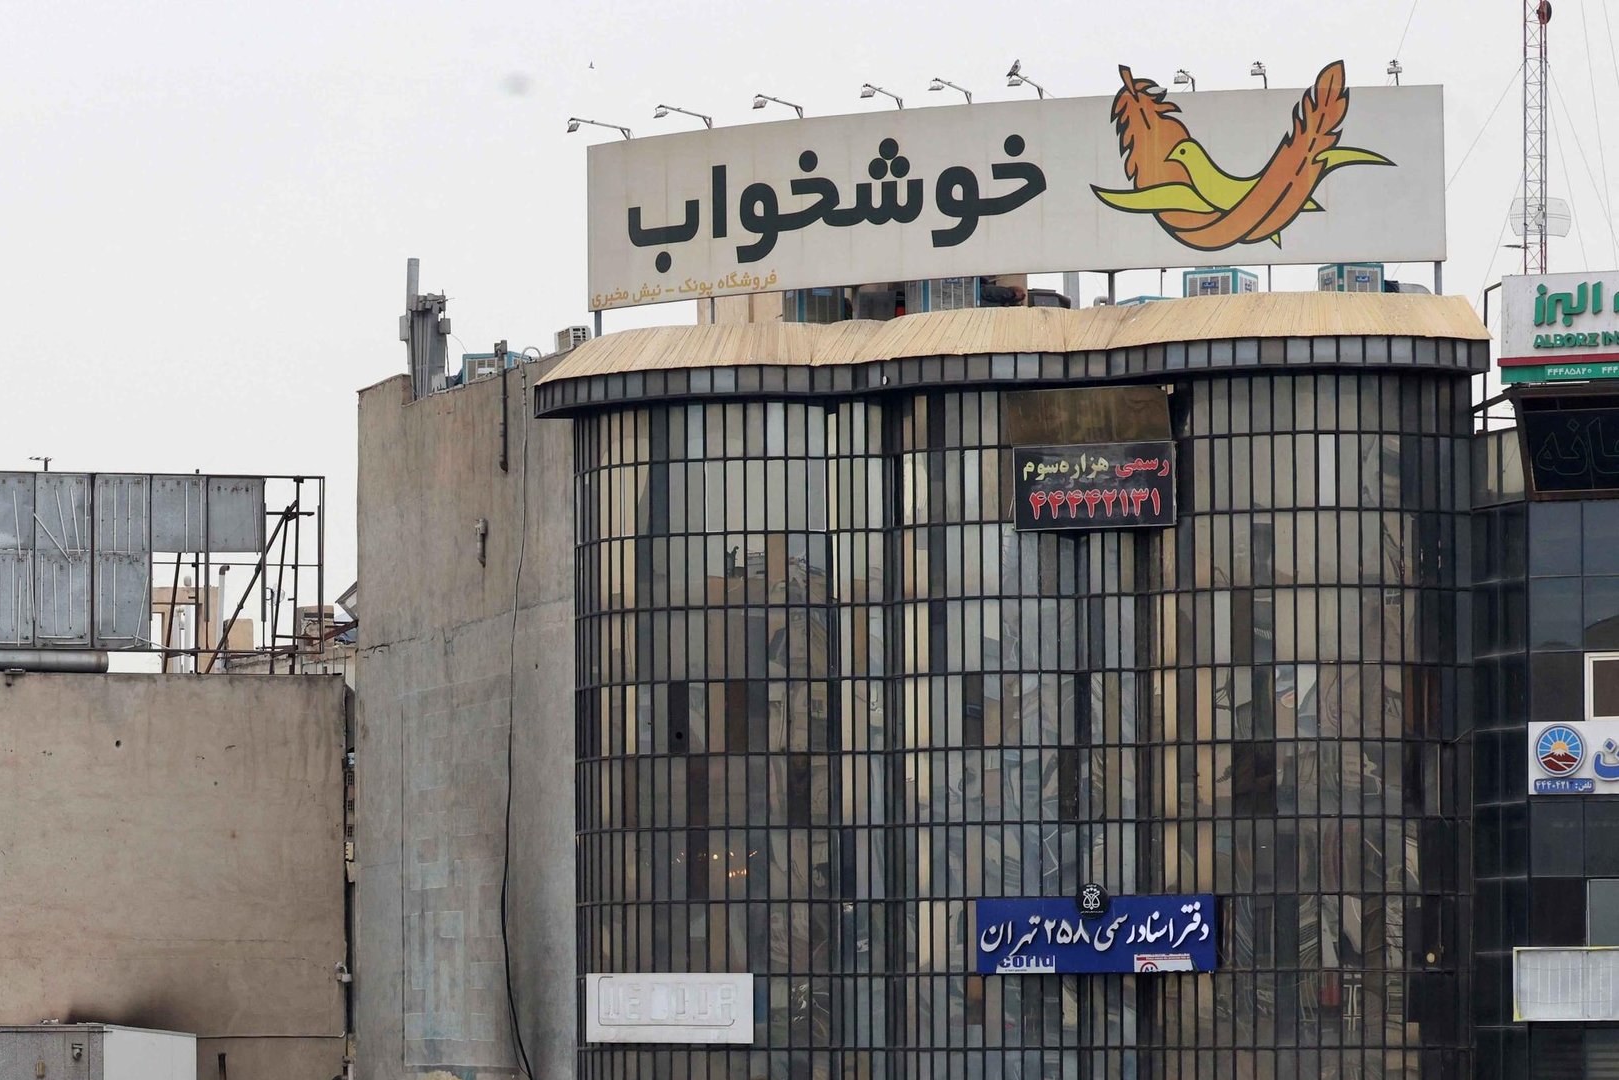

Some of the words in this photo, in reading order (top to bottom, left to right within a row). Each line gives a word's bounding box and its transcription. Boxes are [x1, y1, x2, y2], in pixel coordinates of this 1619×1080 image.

[628, 134, 1047, 273] خوشخواب
[718, 269, 777, 290] فروشگاه
[1534, 281, 1603, 327] البرز
[1534, 333, 1600, 349] ALBORZ
[1115, 457, 1170, 477] رسمی
[980, 915, 1040, 956] تهران
[1044, 919, 1090, 944] ۲۵۸
[1093, 914, 1136, 951] رسمی
[1136, 911, 1175, 943] اسناد
[1172, 902, 1210, 948] دفتر
